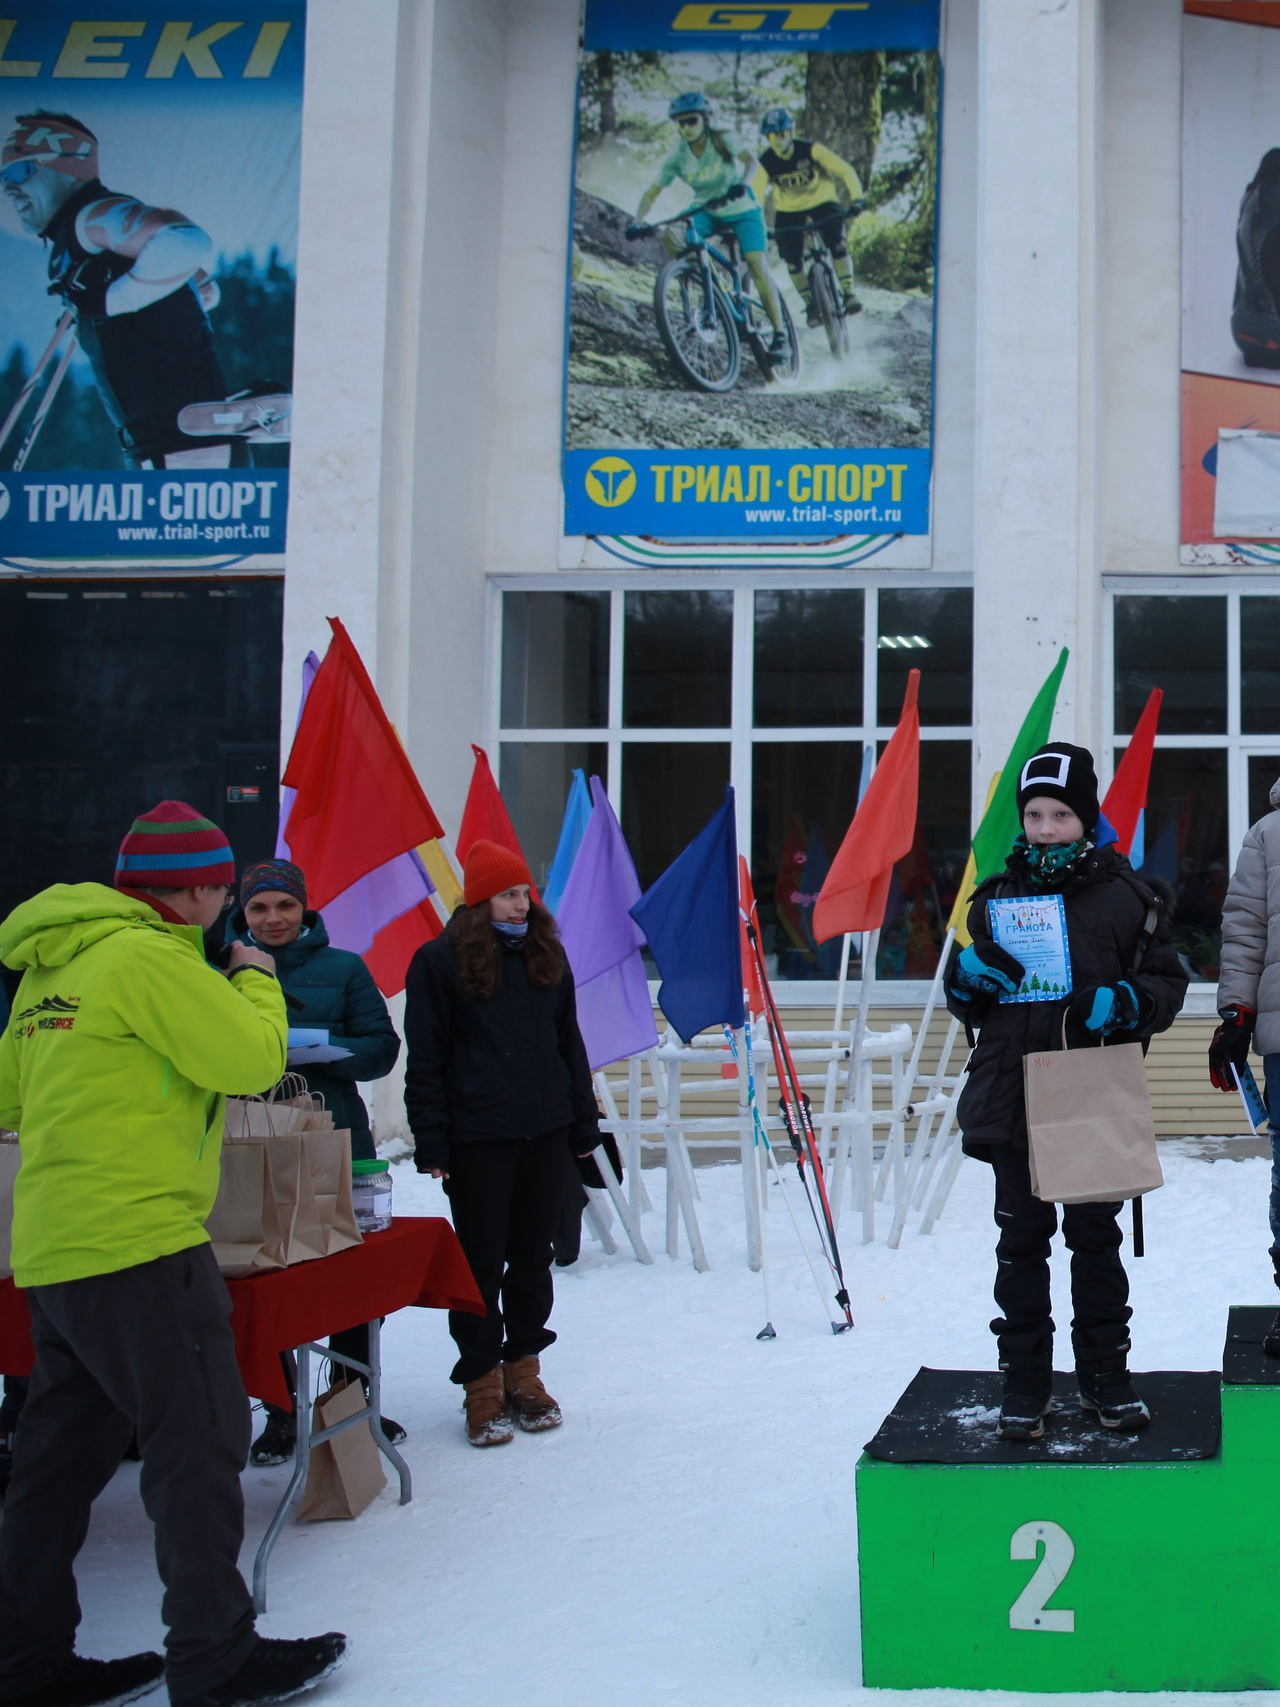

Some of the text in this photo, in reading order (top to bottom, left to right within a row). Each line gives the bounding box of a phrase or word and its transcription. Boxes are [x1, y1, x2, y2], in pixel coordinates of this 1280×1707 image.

[671, 3, 870, 31] GT
[0, 18, 292, 79] LEKI
[740, 32, 819, 41] BICYCLES
[745, 505, 902, 525] www.trial-sport.ru
[118, 523, 271, 542] www.trial-sport.ru
[1005, 922, 1053, 934] ГРАМОТА
[786, 1102, 799, 1135] NORDWAY
[798, 1100, 811, 1133] NORDWAY
[1010, 1520, 1075, 1634] 2
